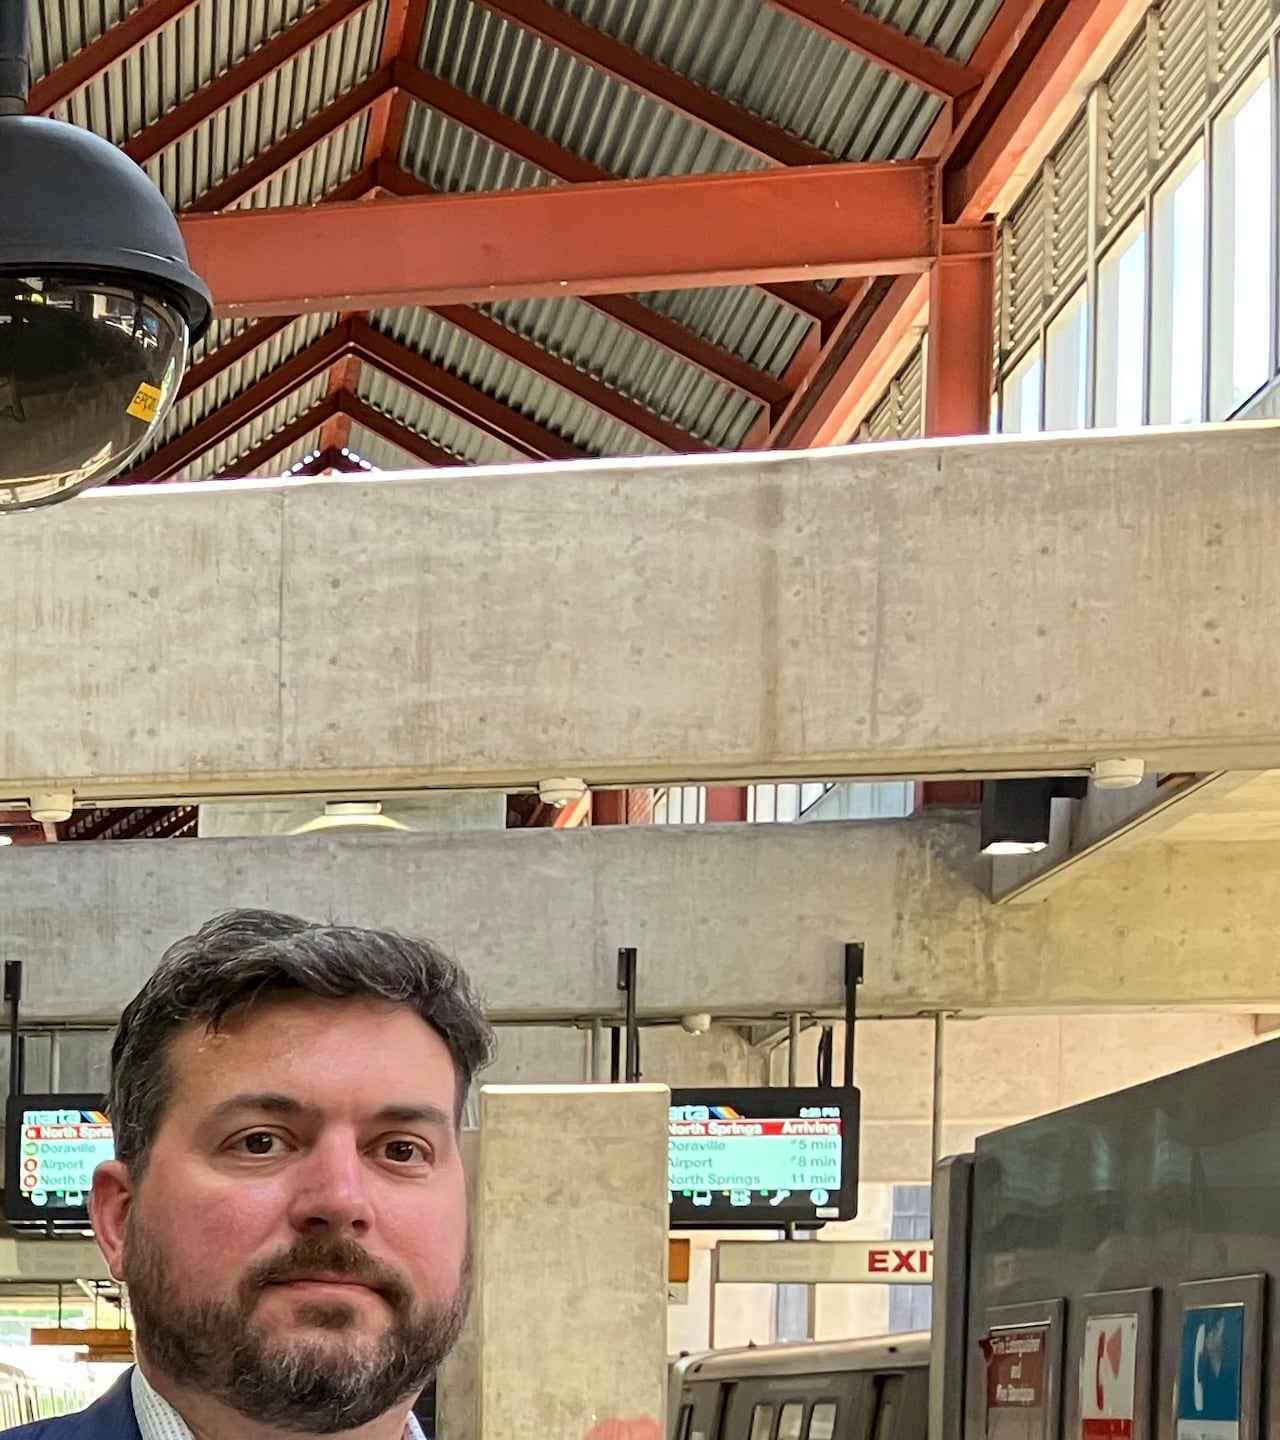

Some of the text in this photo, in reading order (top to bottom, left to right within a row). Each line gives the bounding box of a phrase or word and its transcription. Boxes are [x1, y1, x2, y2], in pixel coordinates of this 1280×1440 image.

[41, 1125, 113, 1140] North Sprin
[708, 1122, 762, 1137] Springs
[782, 1121, 839, 1136] Arriving
[40, 1143, 97, 1154] Doraville
[811, 1139, 837, 1150] min
[40, 1159, 84, 1171] Airport
[810, 1156, 837, 1168] min
[40, 1174, 76, 1186] North
[707, 1173, 761, 1186] Springs
[792, 1172, 805, 1185] 11
[810, 1173, 837, 1185] min
[868, 1250, 933, 1273] EXI
